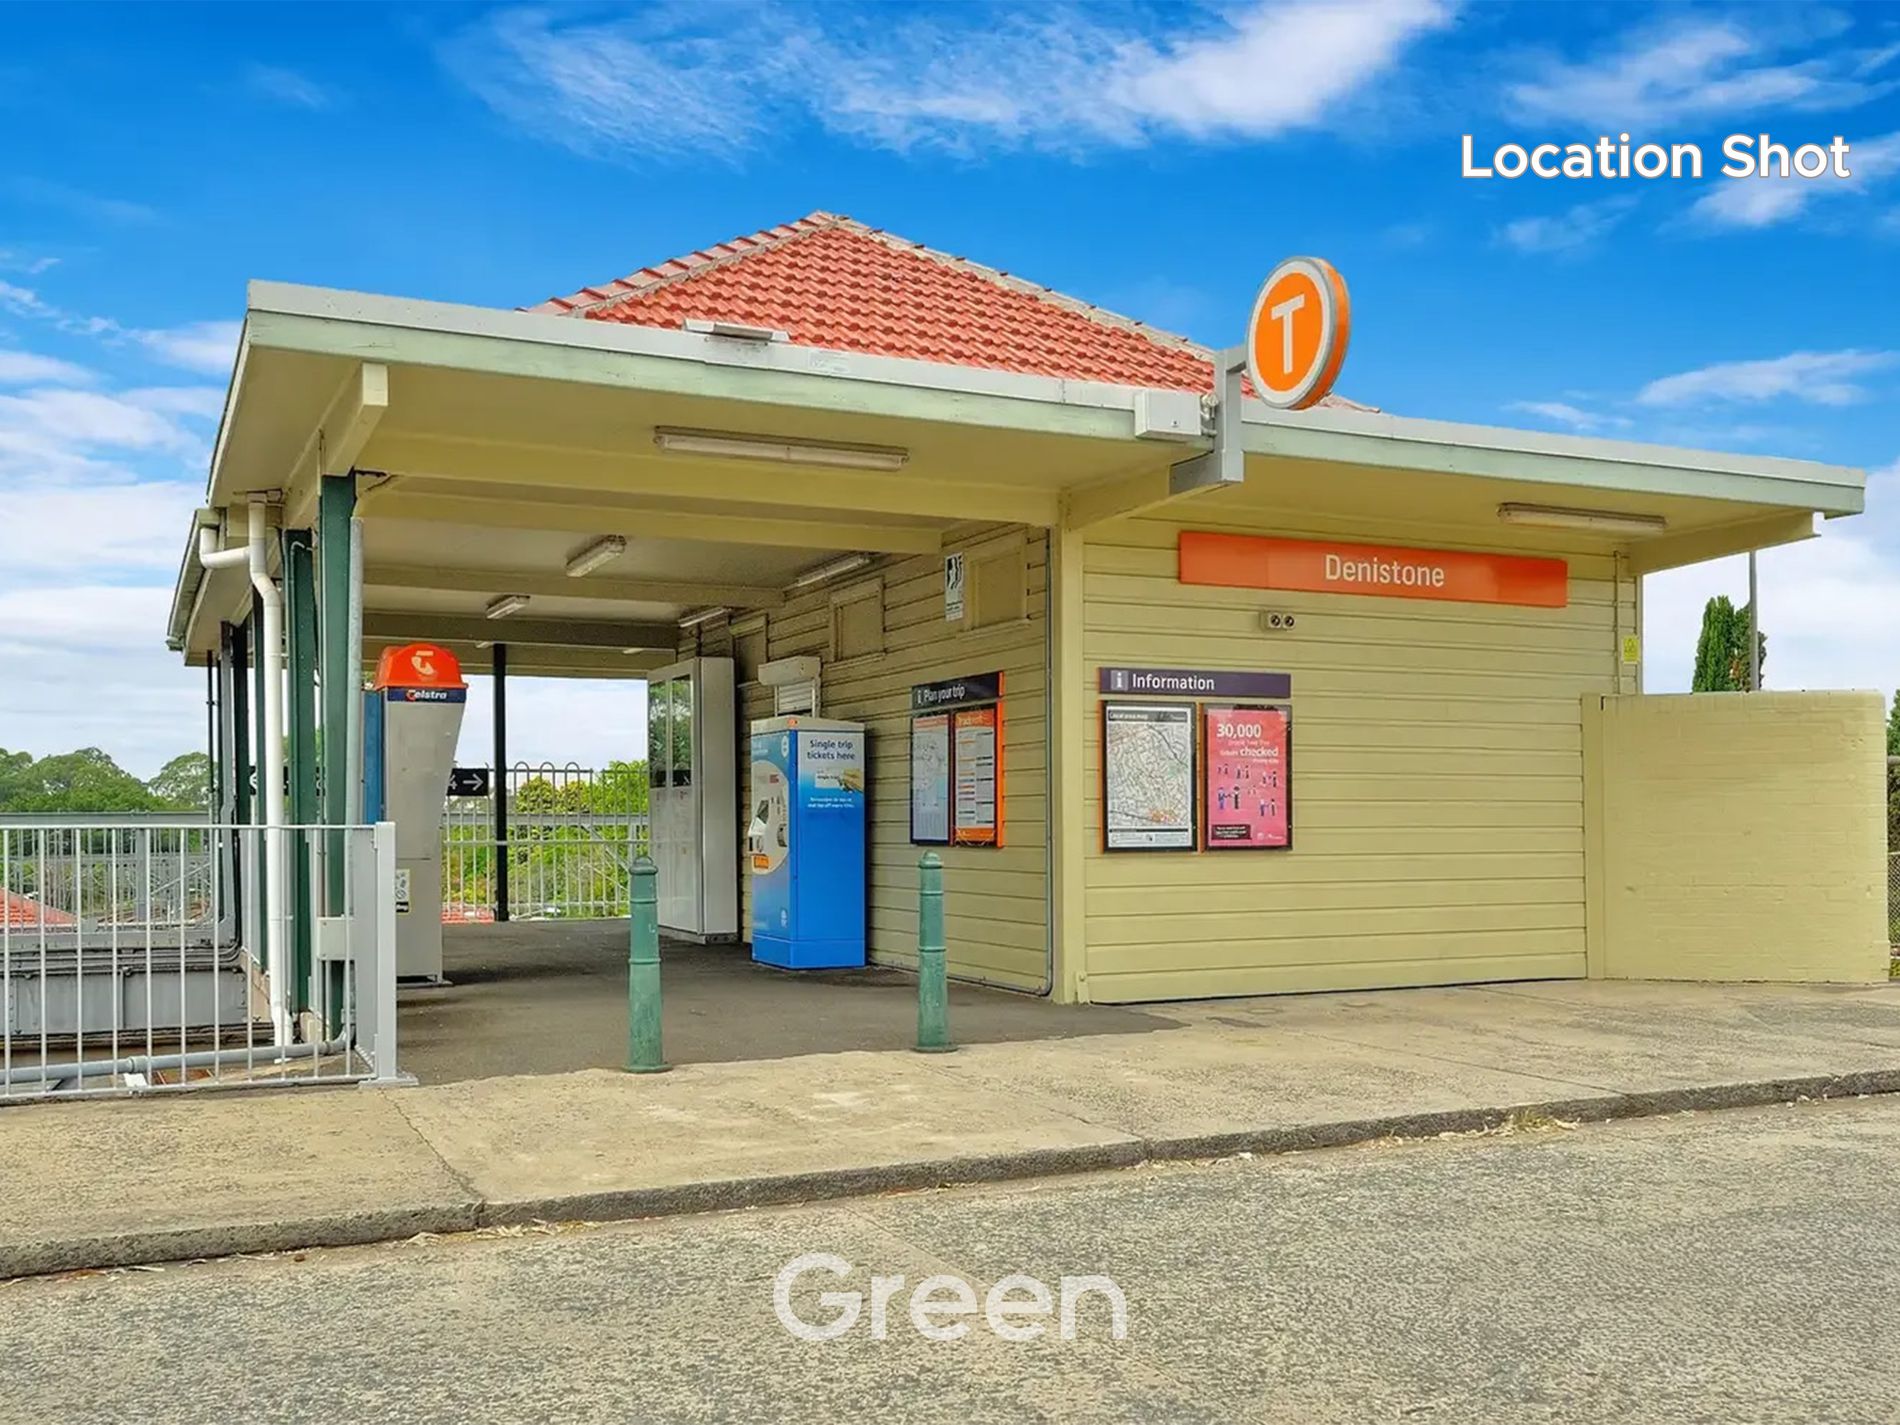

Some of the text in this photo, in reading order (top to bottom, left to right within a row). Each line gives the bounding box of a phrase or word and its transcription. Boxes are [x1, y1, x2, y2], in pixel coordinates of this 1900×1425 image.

[1271, 293, 1305, 375] T
[1325, 554, 1445, 587] Denistone
[1132, 673, 1215, 690] Information
[406, 689, 448, 701] Telstra
[923, 689, 938, 701] Plan
[938, 688, 952, 702] your
[952, 684, 965, 699] trip
[1216, 724, 1262, 739] 30,000
[810, 740, 853, 750] Single trip
[1240, 746, 1279, 756] checked
[807, 752, 855, 760] tickets here
